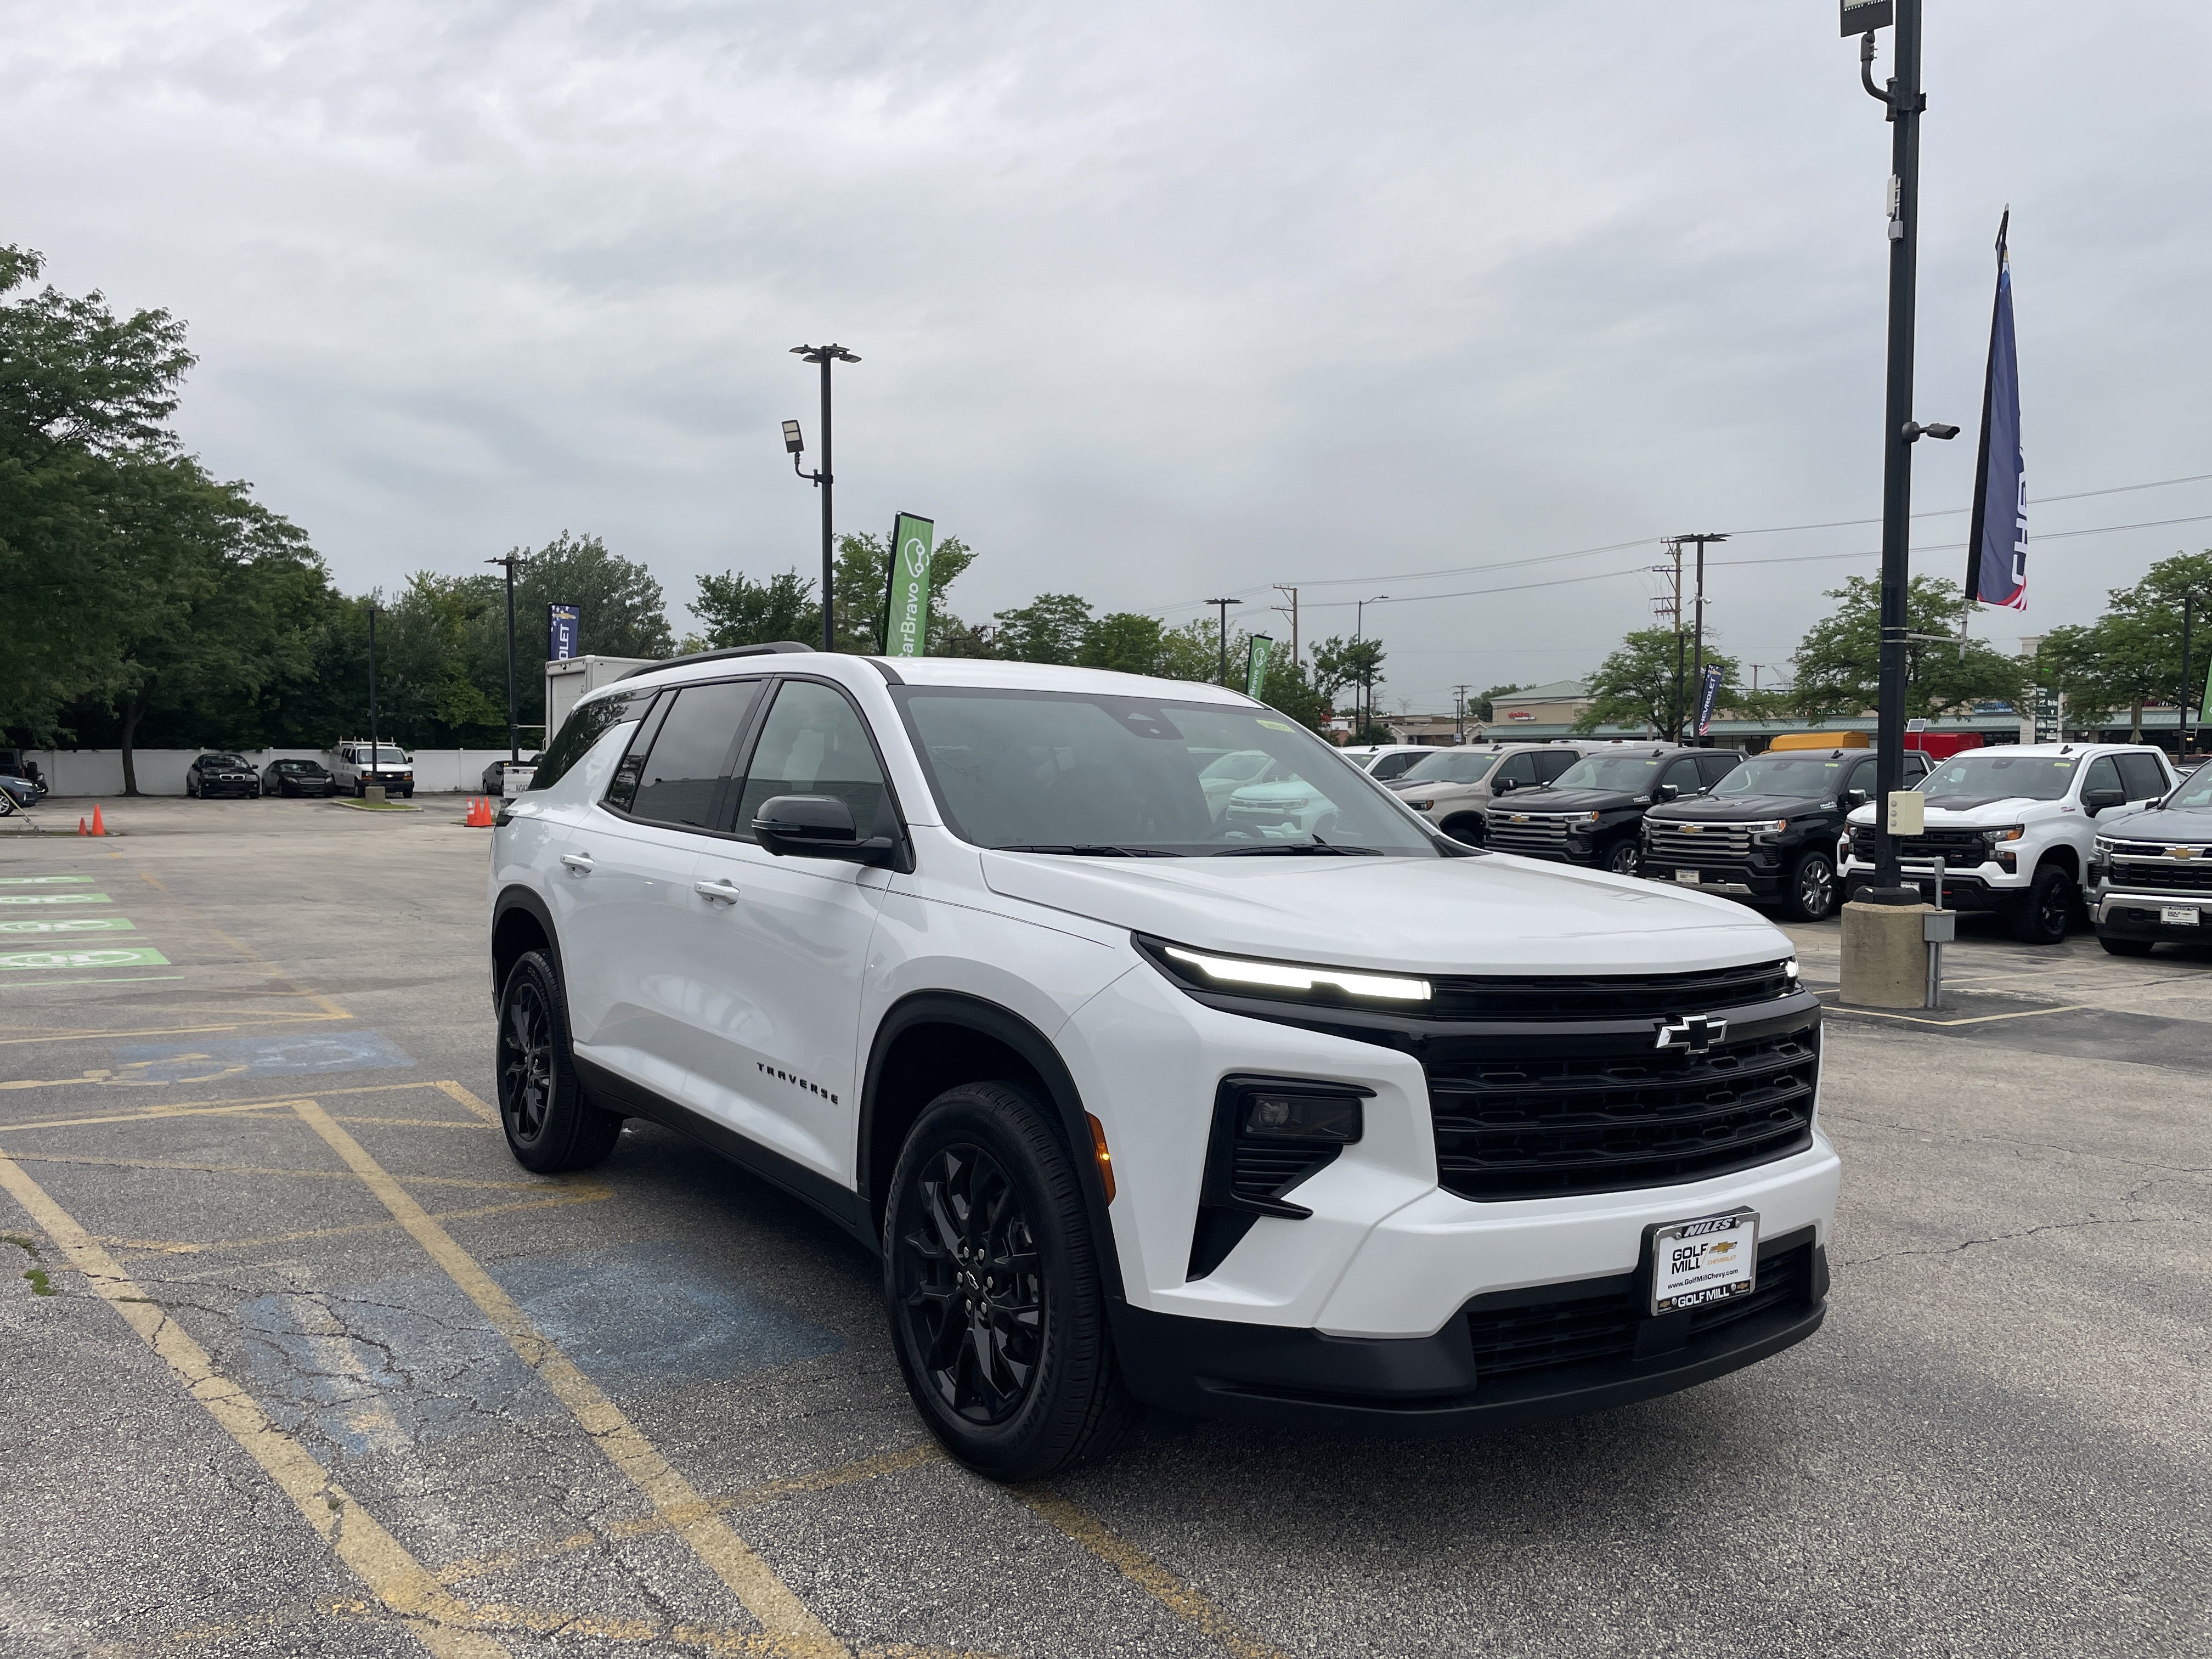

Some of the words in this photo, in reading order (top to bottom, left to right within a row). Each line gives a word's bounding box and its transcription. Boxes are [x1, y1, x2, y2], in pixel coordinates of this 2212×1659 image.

[1249, 669, 1259, 697] Bravo
[1699, 676, 1716, 731] CHEVROLET
[756, 1062, 839, 1105] TRAVERSE
[1684, 1218, 1734, 1238] NILES
[1672, 1242, 1709, 1262] GOLF
[1707, 1254, 1737, 1265] CHEVROLET
[1671, 1257, 1701, 1275] MILL
[1667, 1268, 1739, 1289] www.GolfMillChevy.com
[1678, 1293, 1705, 1308] GOLF
[1706, 1286, 1730, 1301] MILL
